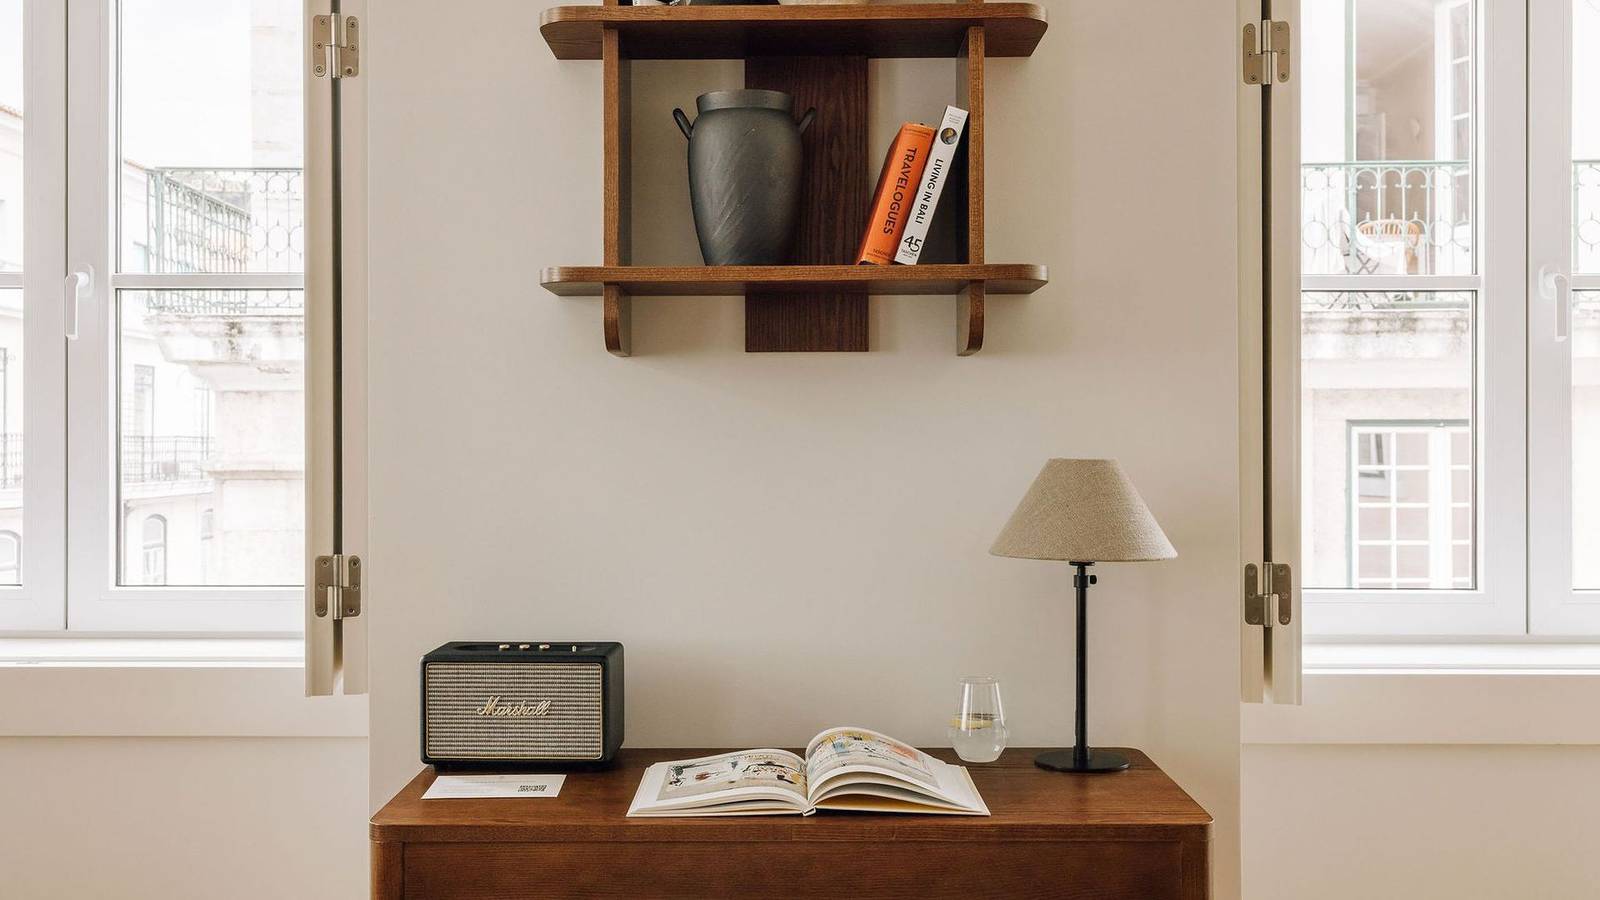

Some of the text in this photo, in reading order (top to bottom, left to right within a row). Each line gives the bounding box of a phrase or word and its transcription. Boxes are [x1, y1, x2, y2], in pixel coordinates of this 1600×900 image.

[883, 148, 917, 235] TRAVELOGUES
[915, 158, 944, 224] LIVING IN BALI
[904, 235, 922, 253] 45
[476, 695, 552, 716] Marshall
